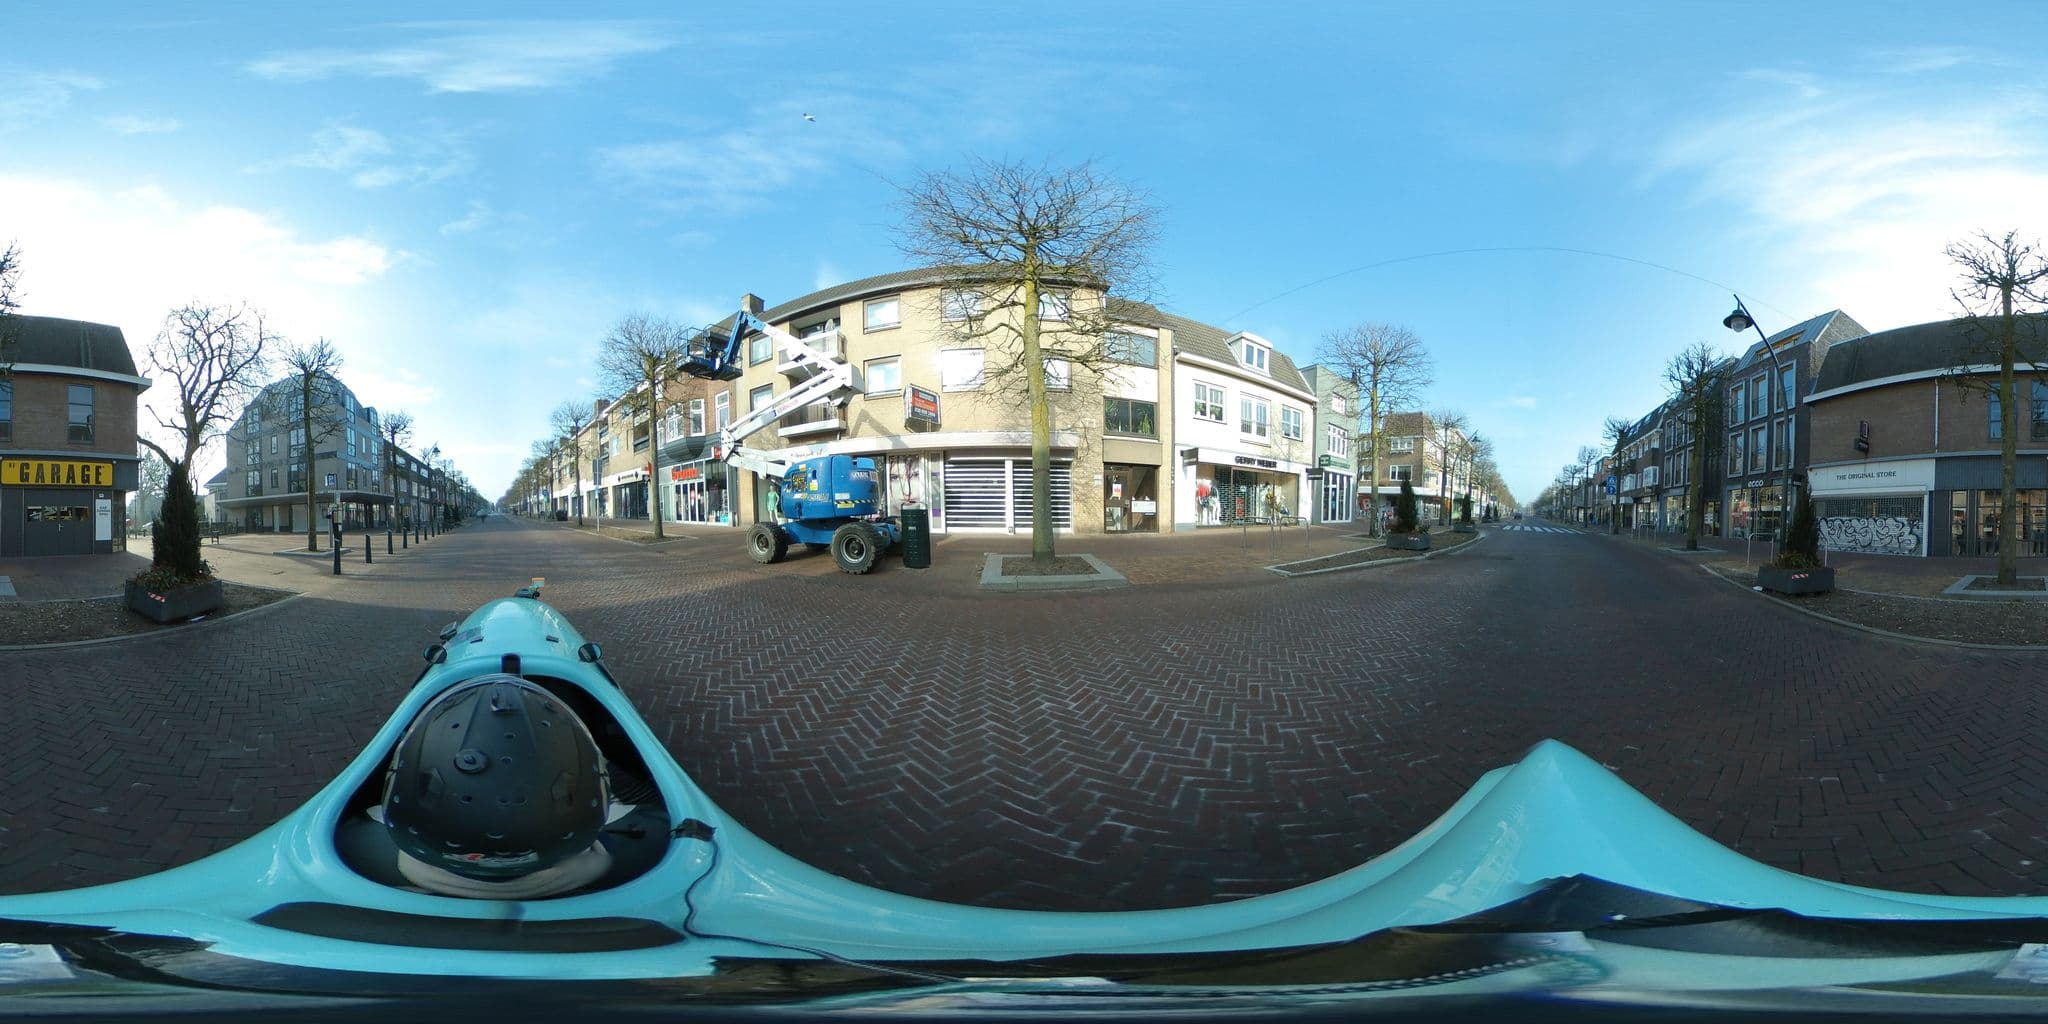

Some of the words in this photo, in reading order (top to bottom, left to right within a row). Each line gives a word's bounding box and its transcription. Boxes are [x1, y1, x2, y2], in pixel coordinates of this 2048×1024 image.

[1234, 455, 1256, 465] GERRY
[1847, 472, 1875, 480] ORIGINAL
[1876, 470, 1897, 478] STORE
[1747, 480, 1764, 488] ecco
